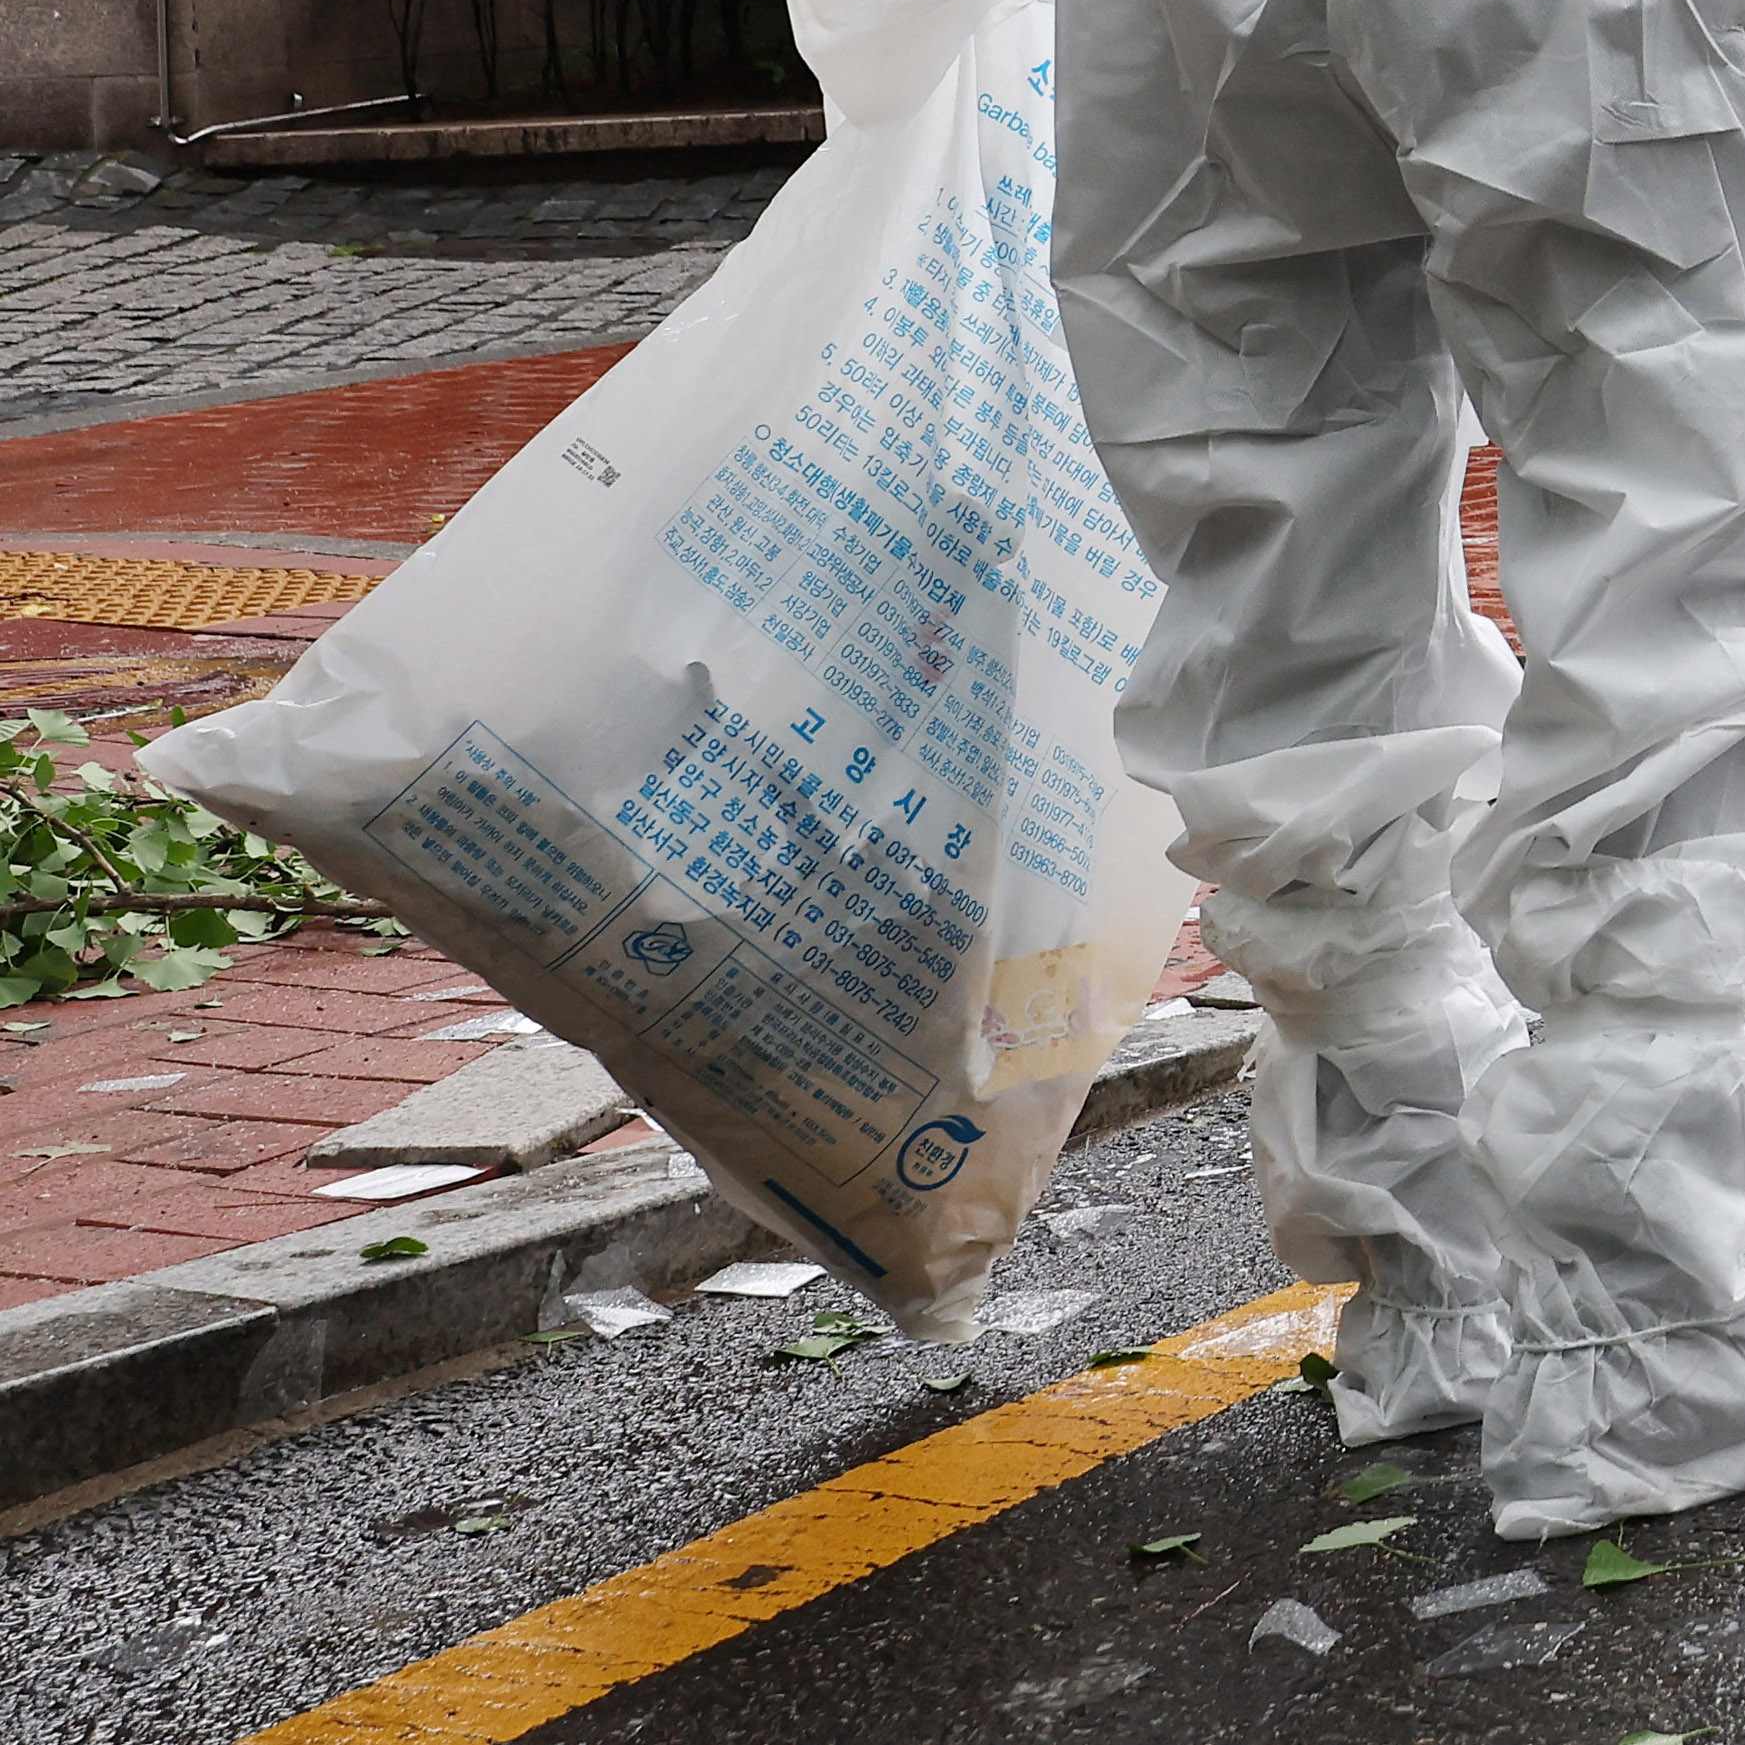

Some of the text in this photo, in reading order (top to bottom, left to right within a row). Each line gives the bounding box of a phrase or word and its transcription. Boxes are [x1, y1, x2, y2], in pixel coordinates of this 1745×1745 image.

[880, 266, 903, 290] 3.
[1026, 392, 1073, 434] 봉투에
[969, 278, 995, 305] 중
[860, 293, 883, 317] 4.
[878, 305, 932, 353] 이봉투
[1049, 448, 1100, 491] 마대에
[817, 341, 841, 366] 5.
[883, 391, 926, 431] 이상
[948, 461, 1001, 508] 종량제
[1080, 542, 1122, 580] 버릴
[1118, 566, 1161, 604] 경우
[875, 424, 932, 477] 압축기
[988, 531, 1019, 562] 수
[939, 414, 1021, 484] 부과됩니다.
[1080, 507, 1136, 552] 담아서
[797, 568, 848, 619] 원당기업
[827, 522, 884, 577] 수창기업
[920, 520, 977, 572] 이하로
[777, 589, 833, 642] 서강기업
[655, 745, 726, 808] 덕양구
[716, 793, 822, 883] 청소농정과
[677, 720, 843, 857] 고양시자원순환과
[699, 695, 863, 830] 고양시민원콜센터
[788, 704, 976, 862] 고 양 시 장
[611, 796, 692, 867] 일산서구
[682, 851, 779, 936] 환경녹지과
[634, 771, 714, 841] 일산동구
[704, 826, 801, 911] 환경녹지과
[912, 1135, 957, 1174] 친환경
